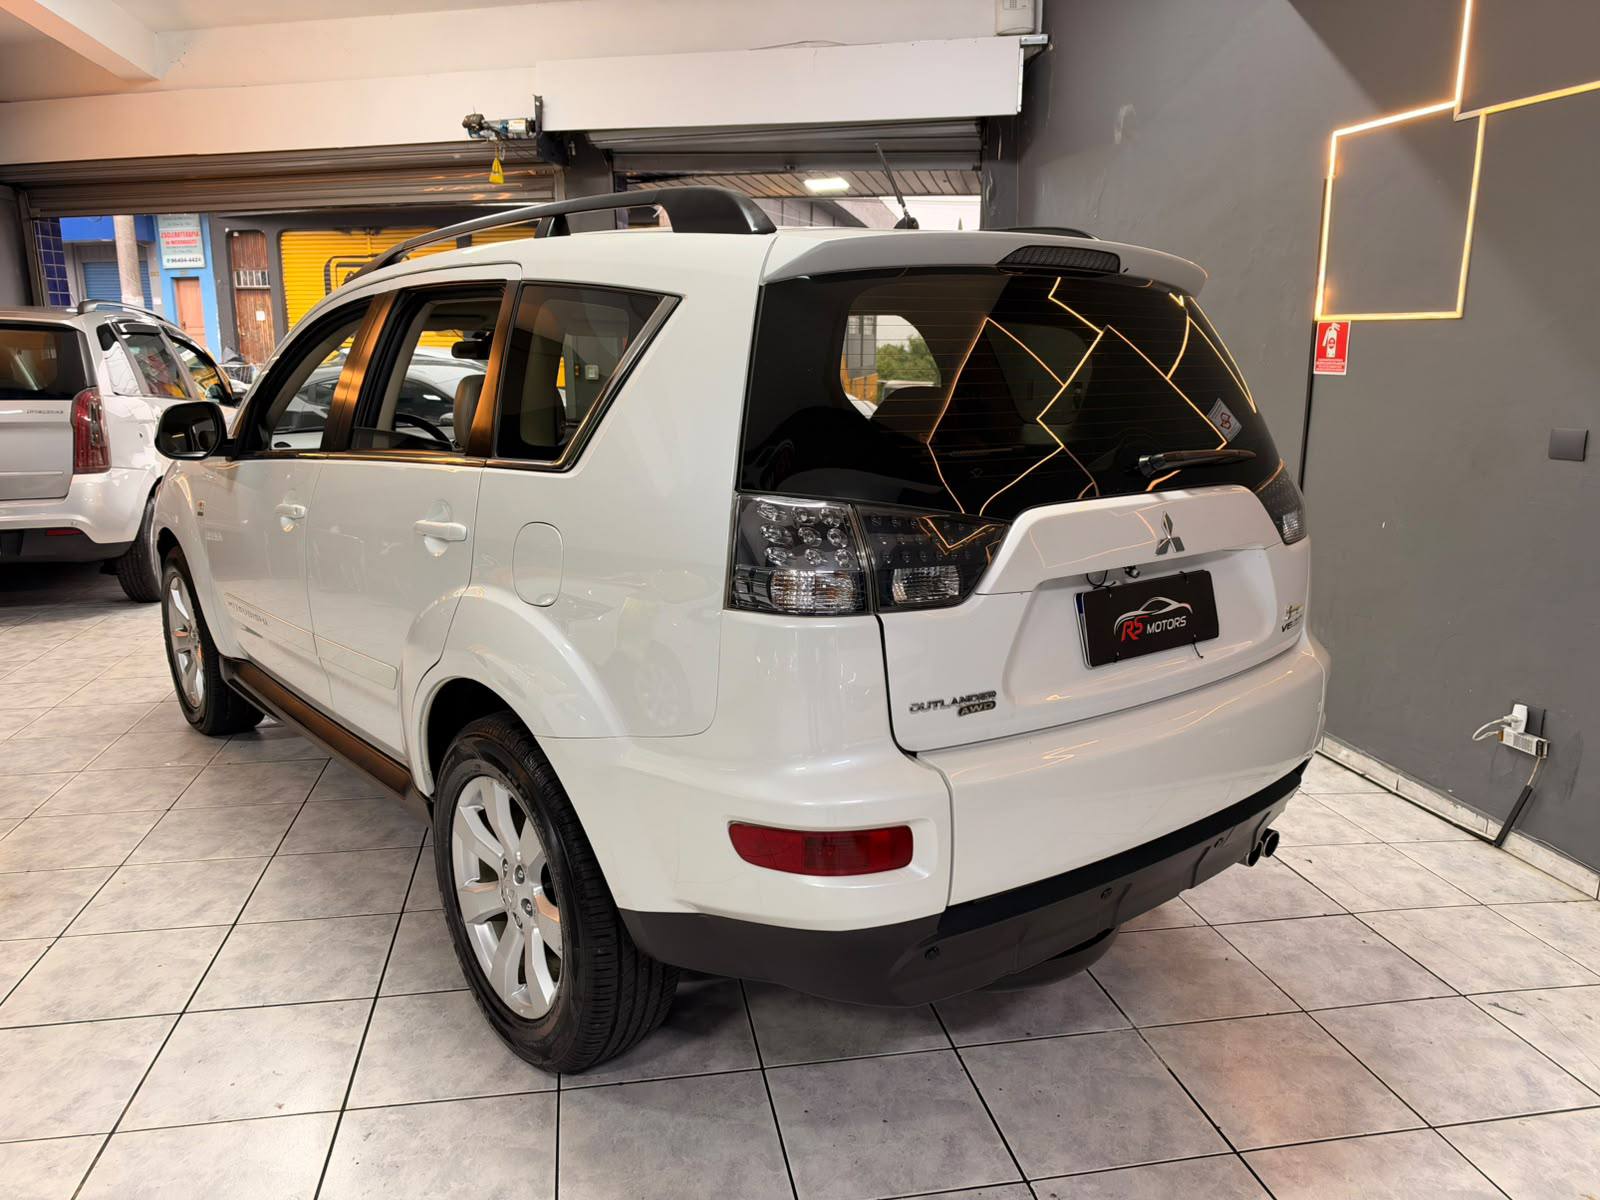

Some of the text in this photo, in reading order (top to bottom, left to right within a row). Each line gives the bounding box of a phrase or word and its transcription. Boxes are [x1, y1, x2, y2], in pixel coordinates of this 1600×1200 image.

[1146, 616, 1187, 634] MOTORS
[908, 690, 997, 713] OUTLANDER
[959, 701, 995, 716] AWD
